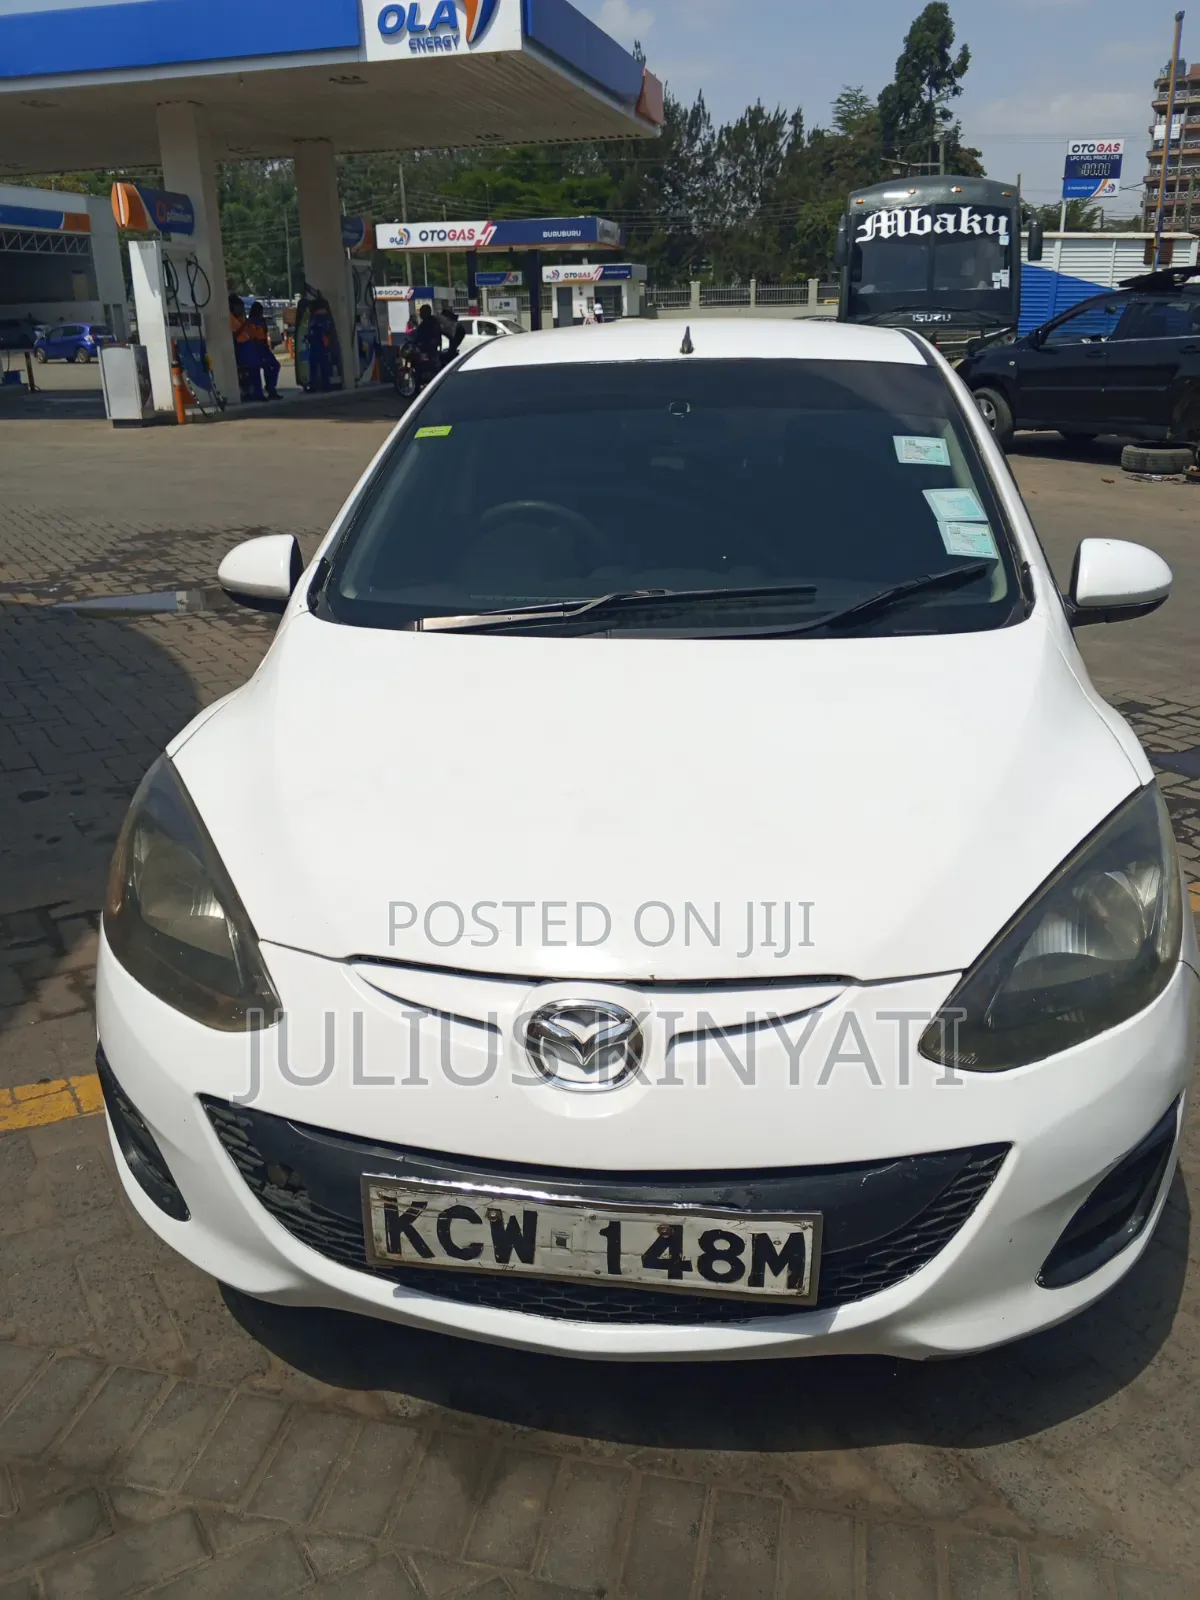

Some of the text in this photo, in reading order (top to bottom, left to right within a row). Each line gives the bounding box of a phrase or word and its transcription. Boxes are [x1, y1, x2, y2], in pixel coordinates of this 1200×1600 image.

[377, 0, 459, 35] OLA
[408, 34, 460, 53] ENERGY
[1071, 143, 1121, 153] OTOGAS
[855, 206, 1009, 243] Mbaku
[418, 229, 476, 242] OTOGAS
[542, 229, 582, 238] BURUBURU
[564, 271, 591, 279] OTOGAS
[911, 313, 952, 323] ISUZU
[382, 1195, 807, 1290] KCW 148M
